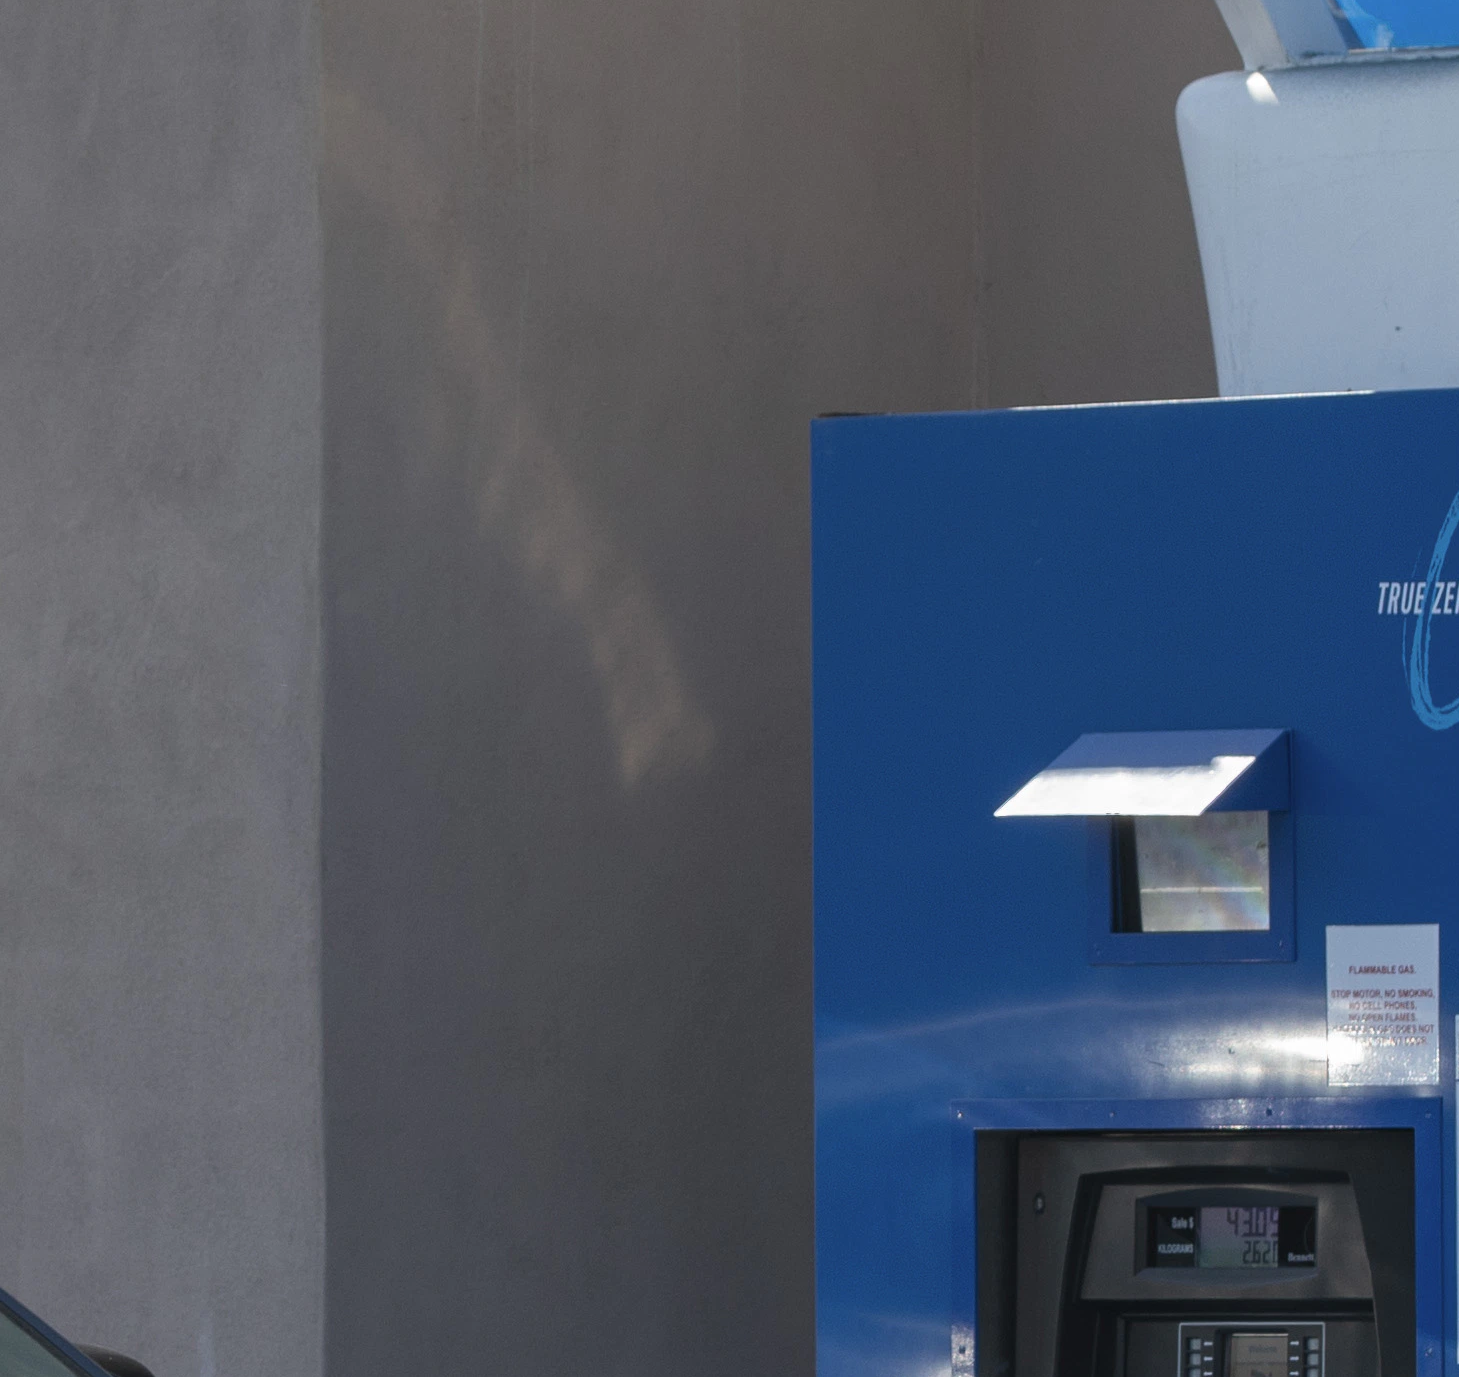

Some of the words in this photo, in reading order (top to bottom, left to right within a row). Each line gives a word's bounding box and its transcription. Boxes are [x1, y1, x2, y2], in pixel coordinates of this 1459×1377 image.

[1378, 581, 1427, 615] TRUE
[1348, 965, 1396, 975] FLAMMABLE
[1331, 989, 1351, 999] STOP
[1384, 989, 1396, 998] NO
[1349, 1001, 1360, 1011] NO
[1361, 1001, 1382, 1011] CELL
[1418, 1023, 1435, 1033] NOT
[1157, 1243, 1194, 1254] KILOGRAMS
